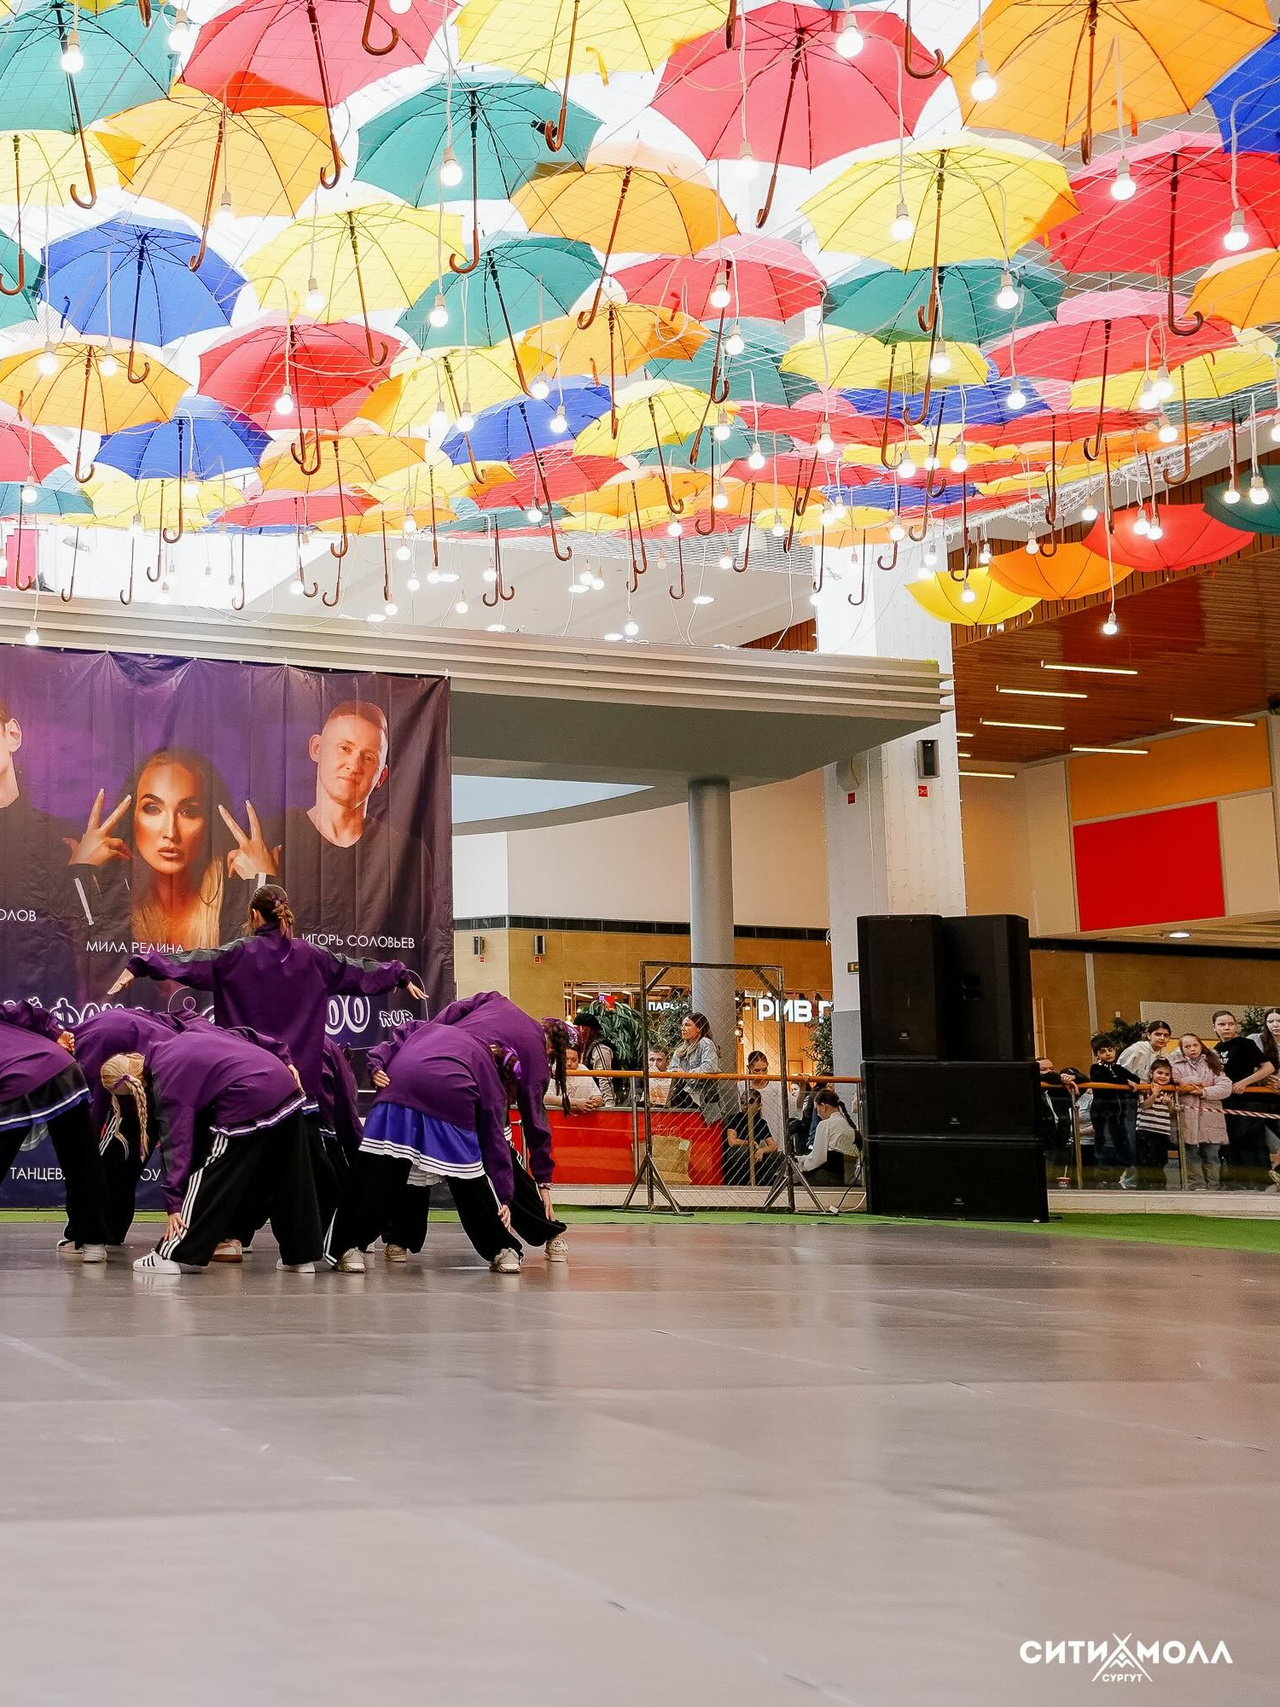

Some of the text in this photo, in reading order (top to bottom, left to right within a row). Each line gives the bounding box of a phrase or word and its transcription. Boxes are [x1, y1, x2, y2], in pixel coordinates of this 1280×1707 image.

[85, 940, 128, 954] МИЛА
[301, 933, 416, 949] ИГОРЬ СОЛОВЬЕВ
[10, 1167, 66, 1182] ТАНЦЕВ
